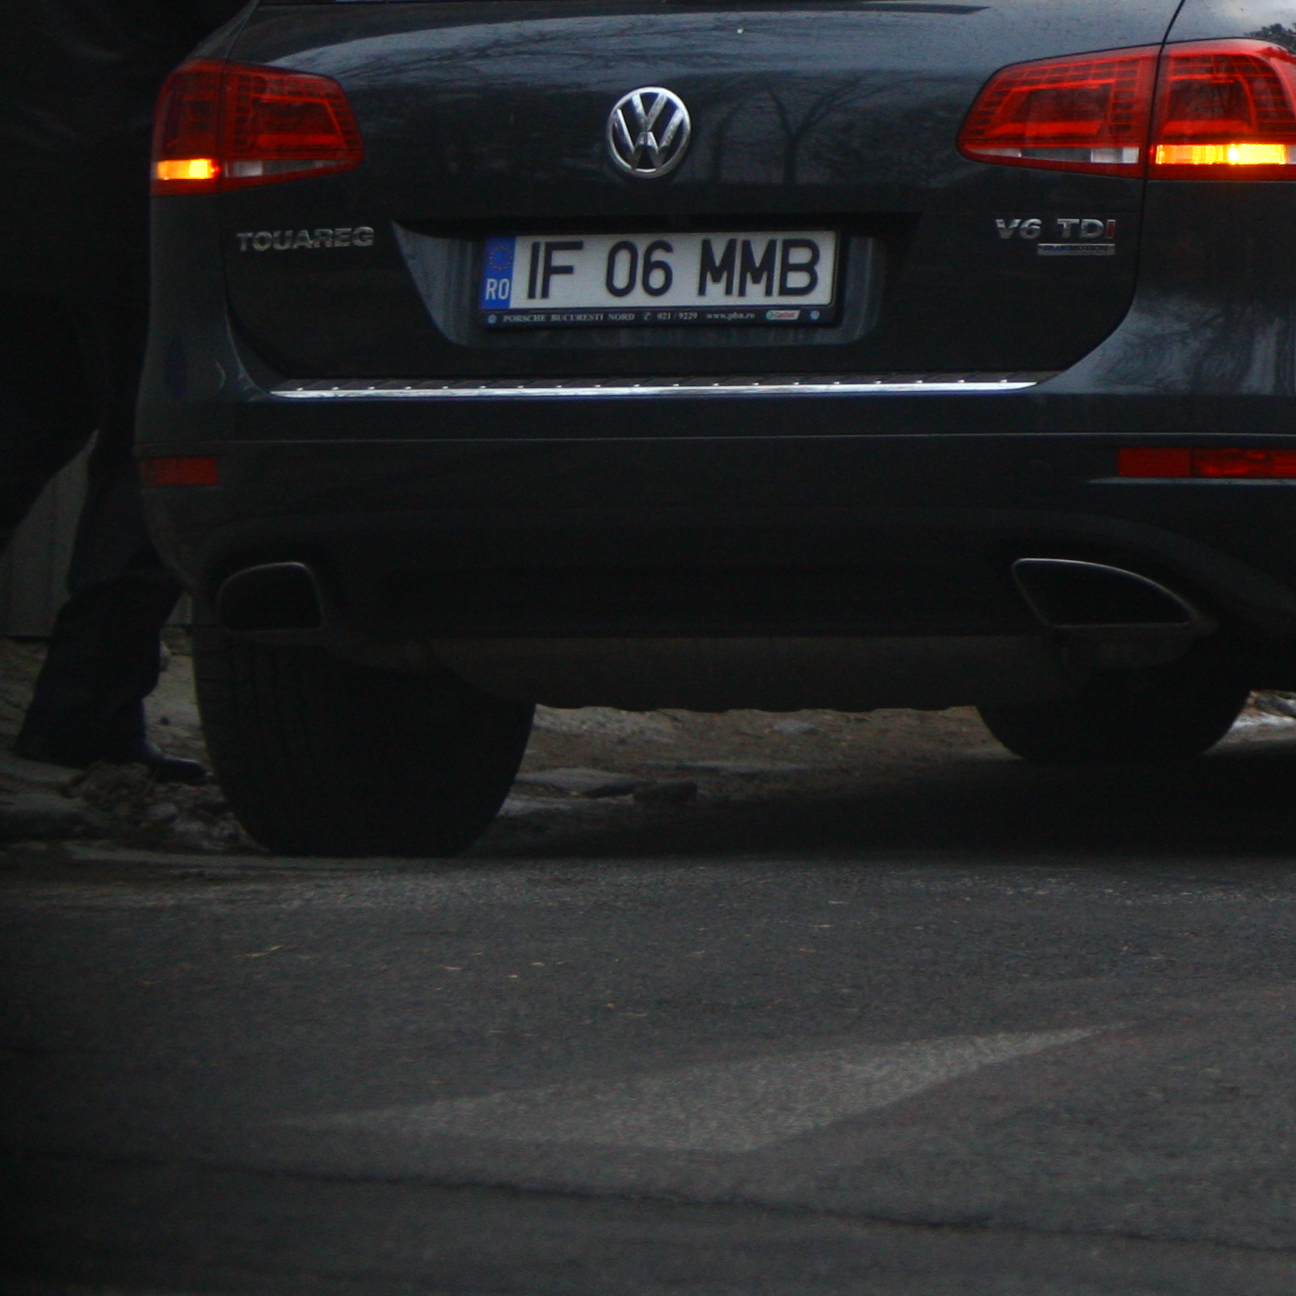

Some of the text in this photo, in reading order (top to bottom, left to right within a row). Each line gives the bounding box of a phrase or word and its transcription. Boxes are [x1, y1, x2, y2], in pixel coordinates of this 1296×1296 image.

[607, 86, 691, 178] VW
[236, 226, 375, 252] TOUAREG
[995, 218, 1116, 240] V6 TDI
[527, 238, 822, 300] IF 06 MMB
[485, 278, 510, 301] RO
[502, 315, 547, 323] PORSCHE
[608, 312, 636, 321] NORD
